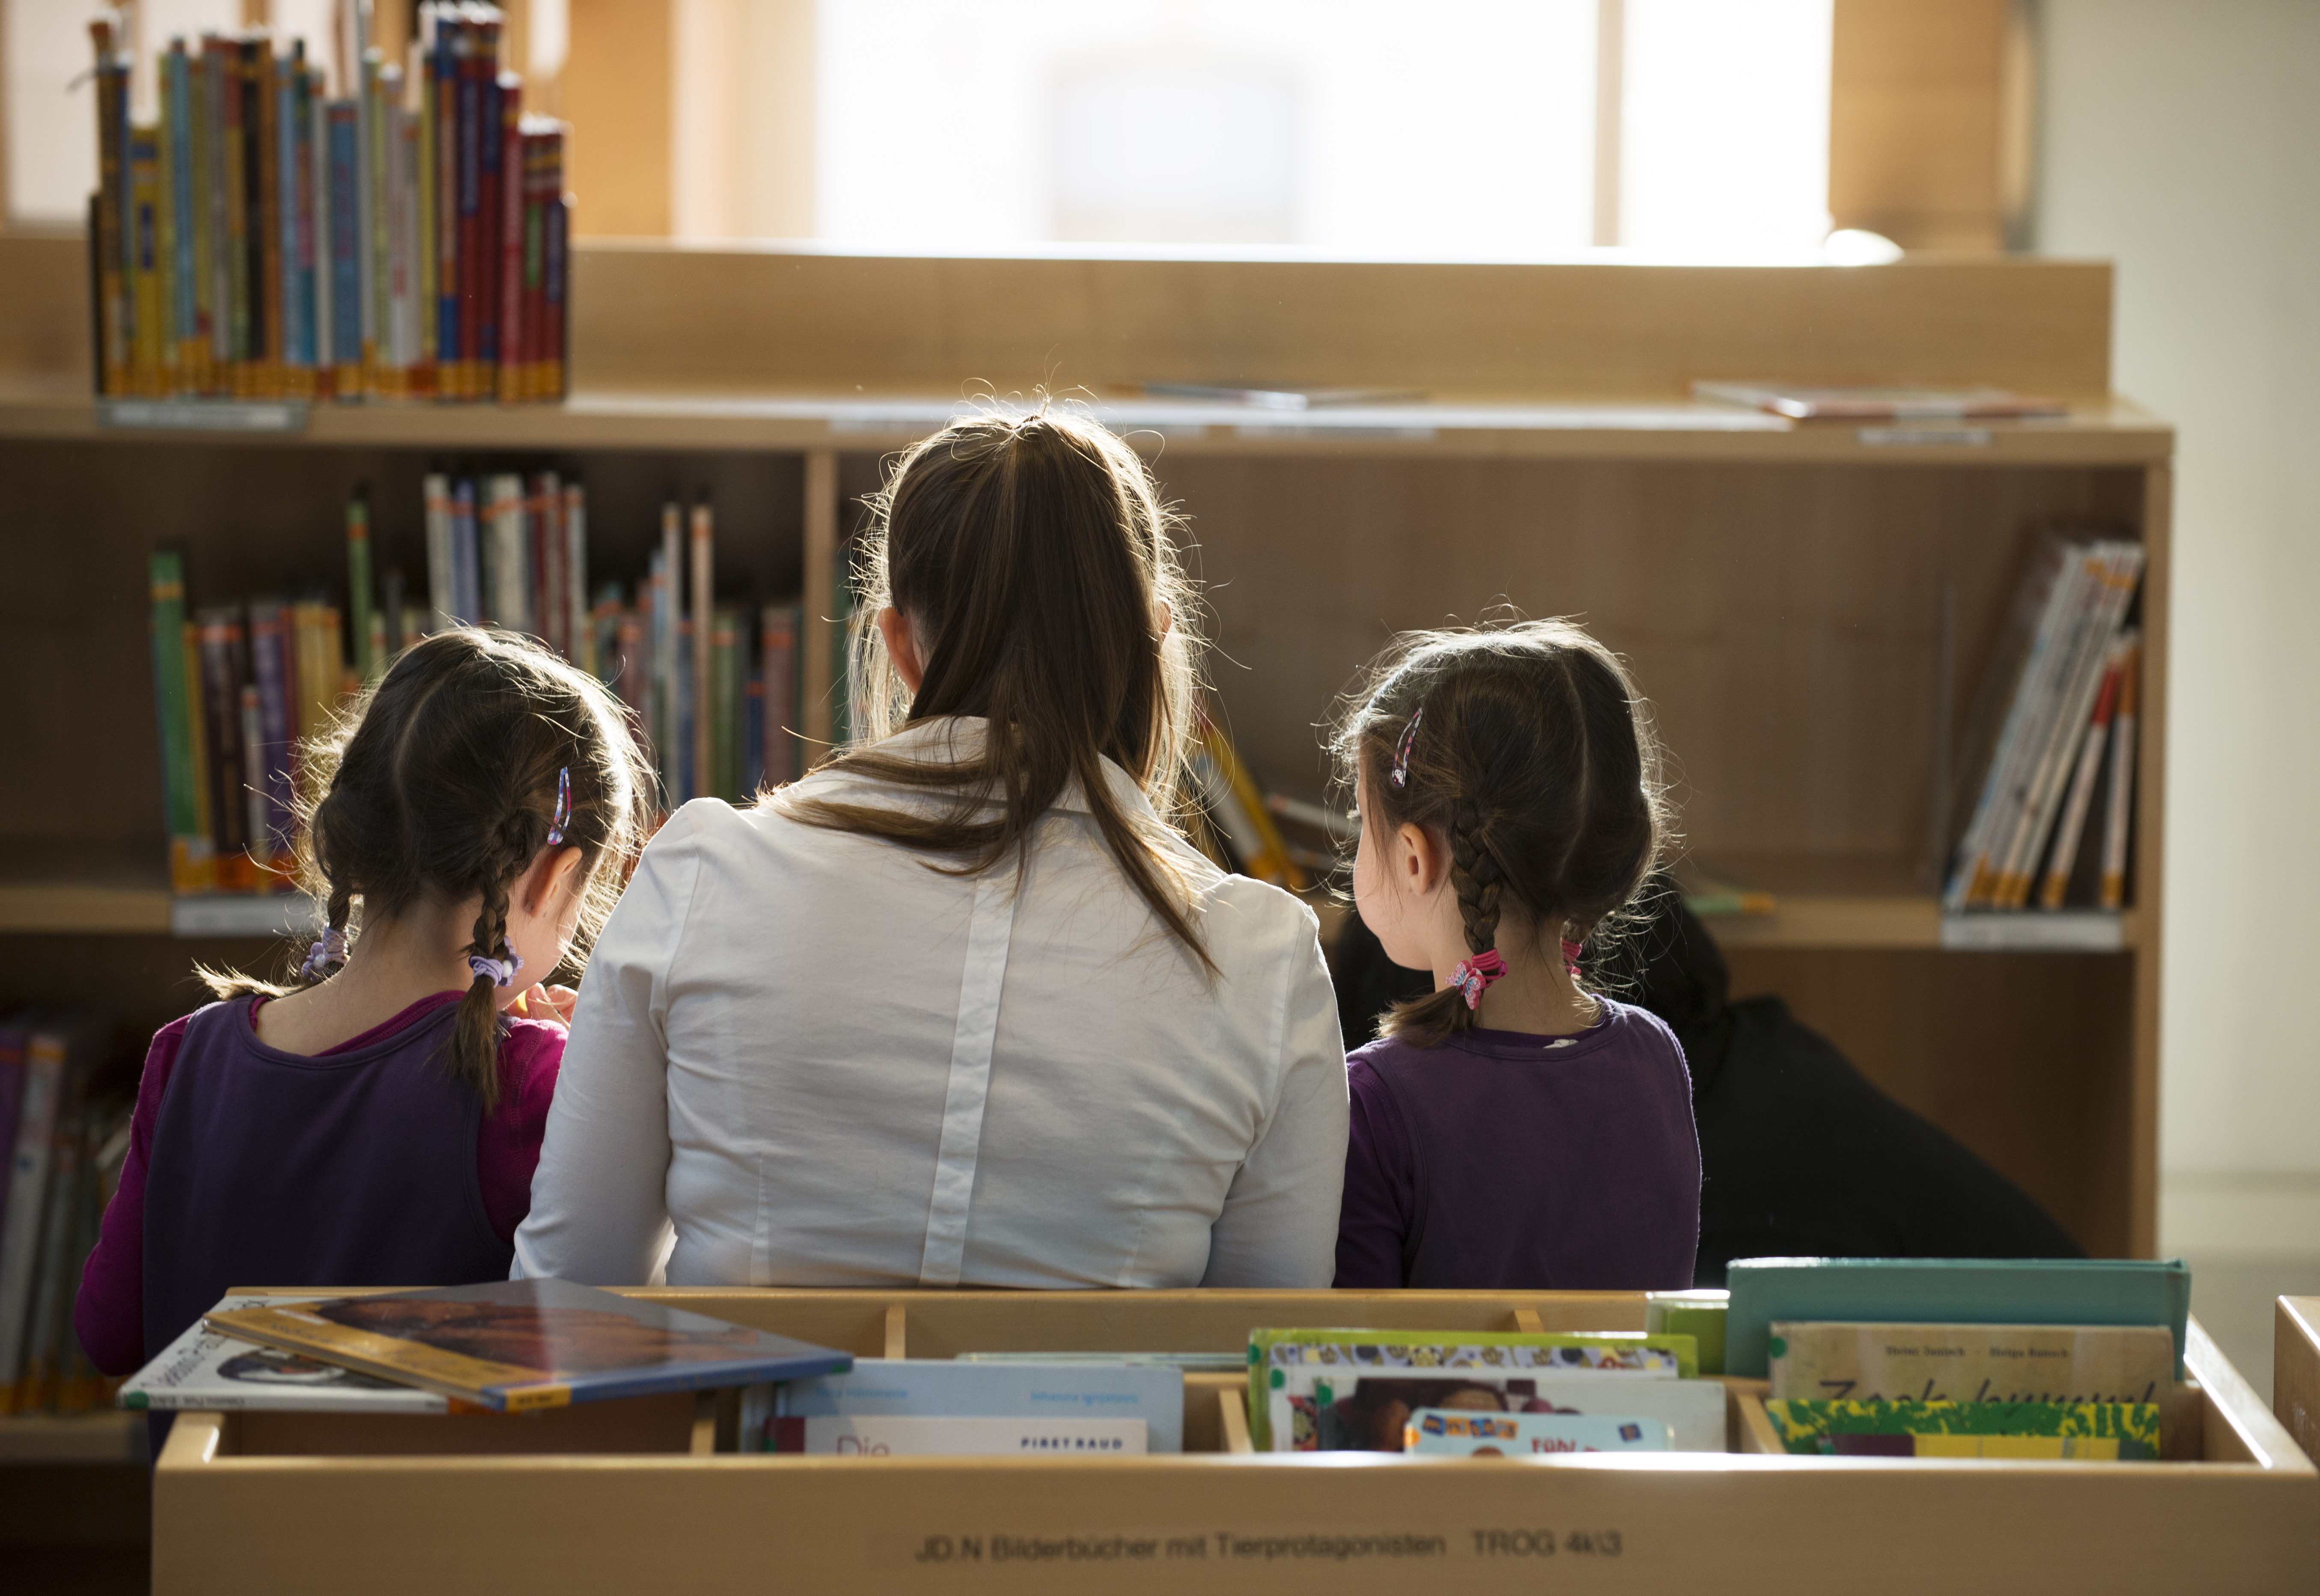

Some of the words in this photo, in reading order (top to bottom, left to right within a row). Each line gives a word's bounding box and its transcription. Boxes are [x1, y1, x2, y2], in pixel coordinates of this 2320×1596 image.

[1020, 1436, 1070, 1450] PIRET
[1075, 1437, 1123, 1450] RAUD
[990, 1533, 1158, 1563] Bilderbücher
[1166, 1535, 1207, 1560] mit
[1215, 1530, 1448, 1561] Tierprotagonisten
[1471, 1527, 1556, 1558] TROG
